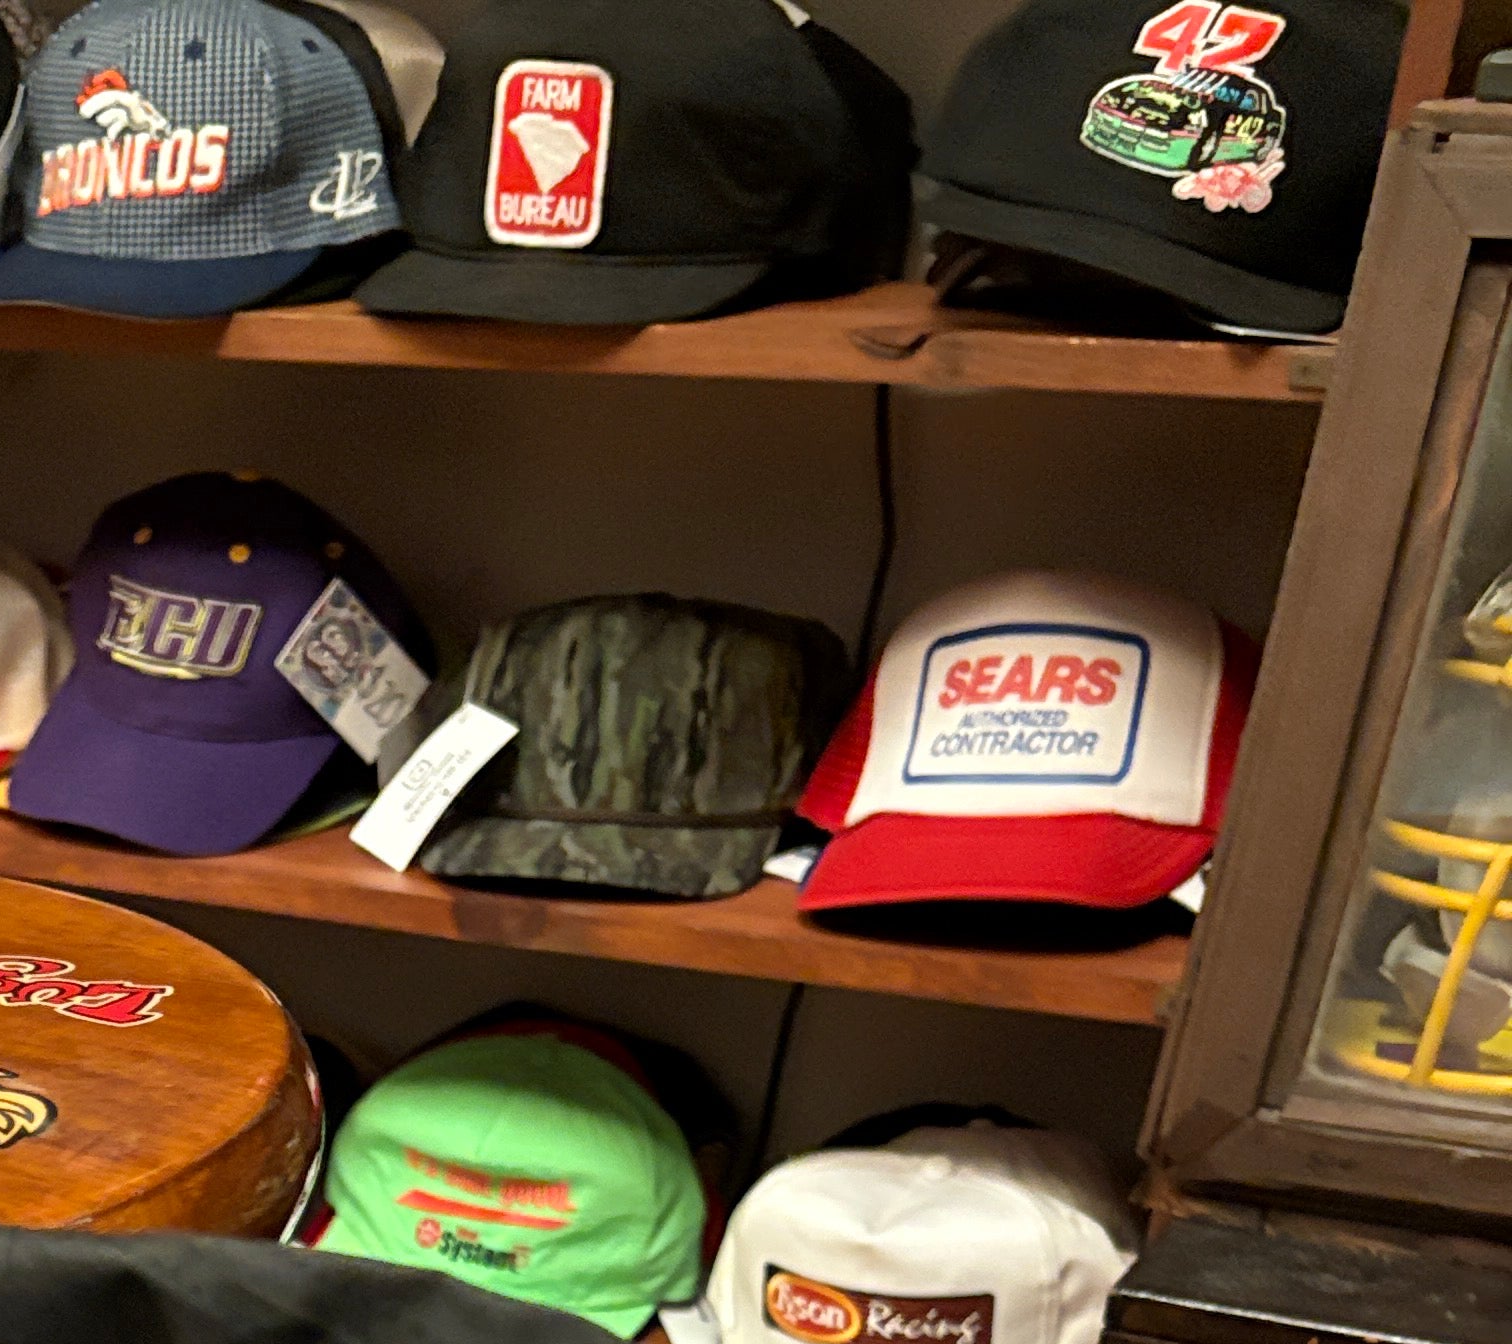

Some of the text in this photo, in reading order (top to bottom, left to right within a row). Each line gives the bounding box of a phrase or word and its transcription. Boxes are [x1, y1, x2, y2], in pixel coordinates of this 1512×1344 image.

[1133, 0, 1286, 78] 42
[521, 77, 583, 112] FARM
[38, 124, 230, 217] BRONCOS
[499, 192, 587, 228] BUREAU
[96, 575, 262, 680] ECU
[938, 654, 1122, 710] SEARS
[930, 729, 1100, 757] CONTRACTOR
